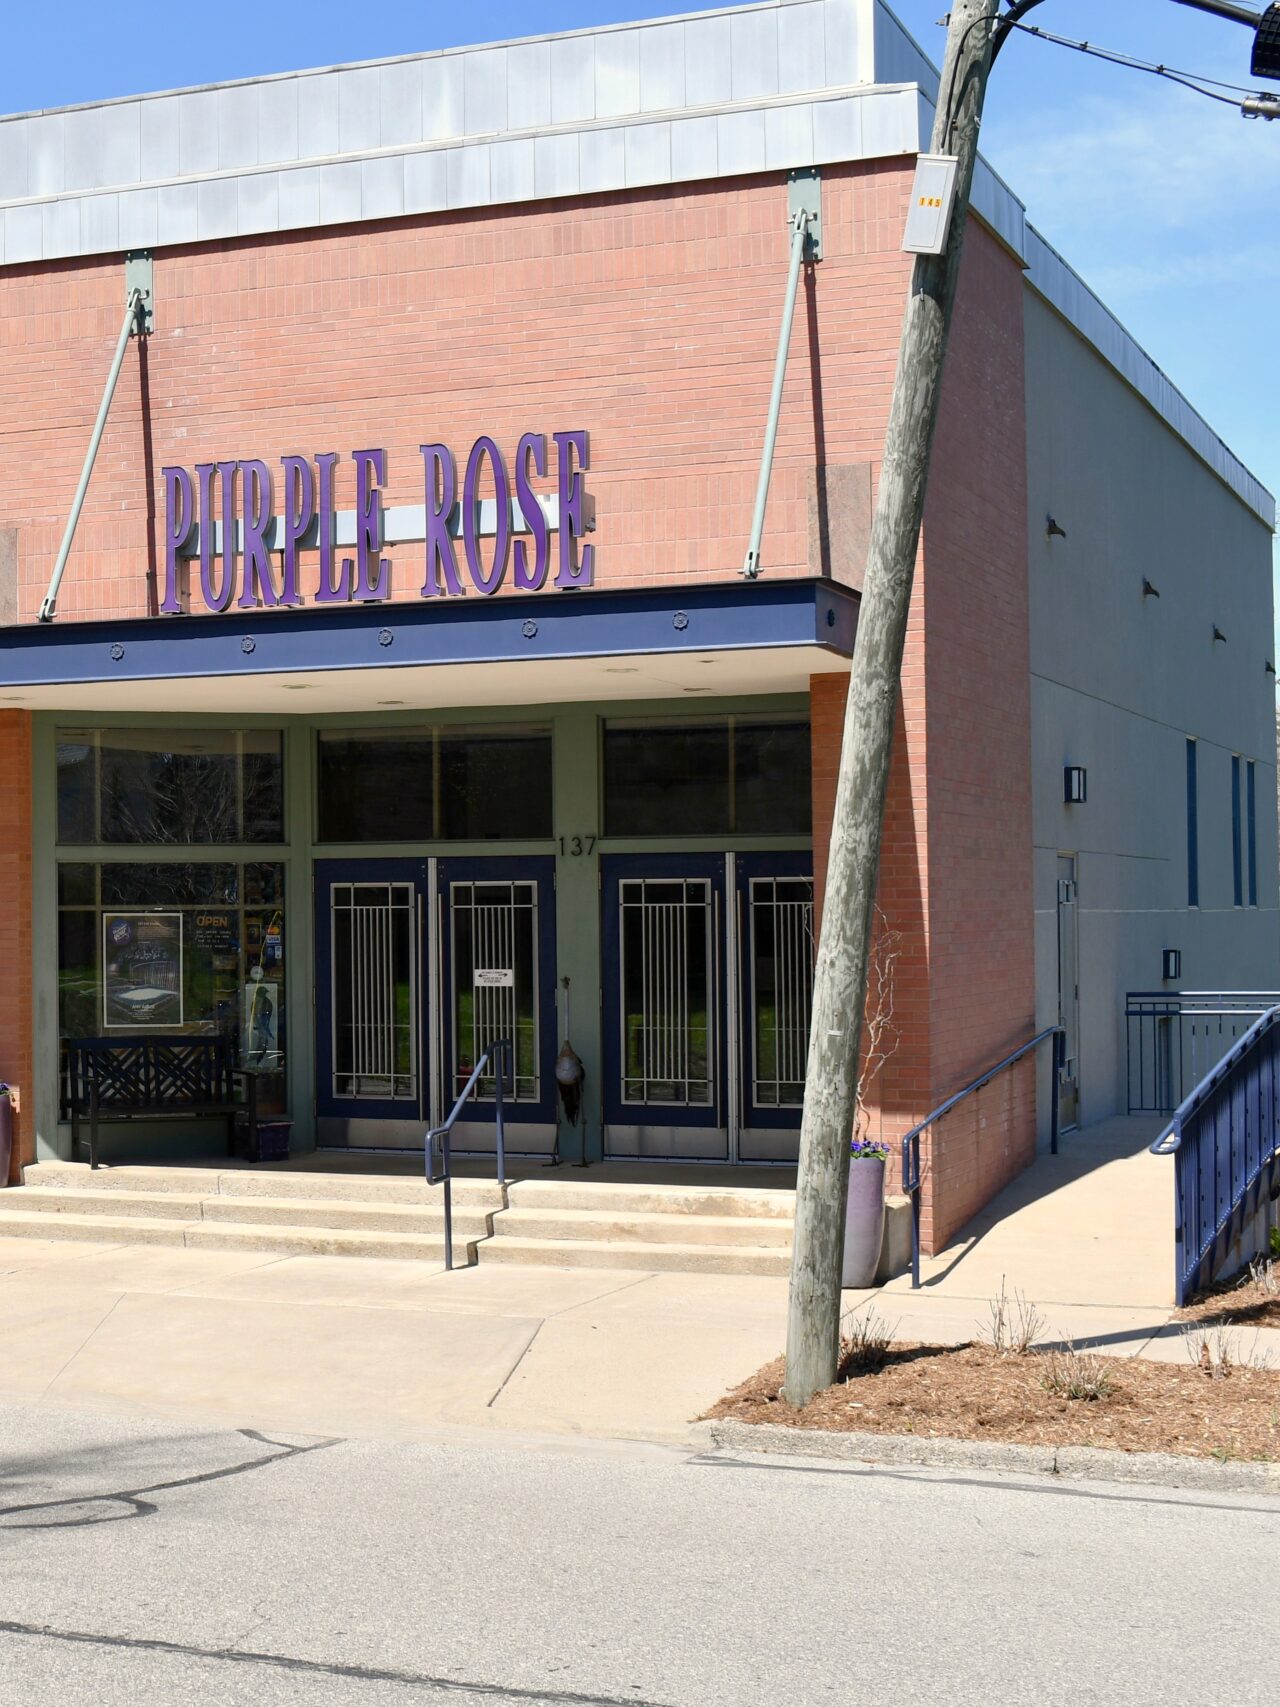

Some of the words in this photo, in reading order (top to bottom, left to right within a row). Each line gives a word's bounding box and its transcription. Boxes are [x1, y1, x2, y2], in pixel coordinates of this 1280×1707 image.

[161, 448, 392, 614] PURPLE
[419, 429, 595, 598] ROSE
[559, 836, 596, 857] 137
[196, 915, 228, 928] OPEN
